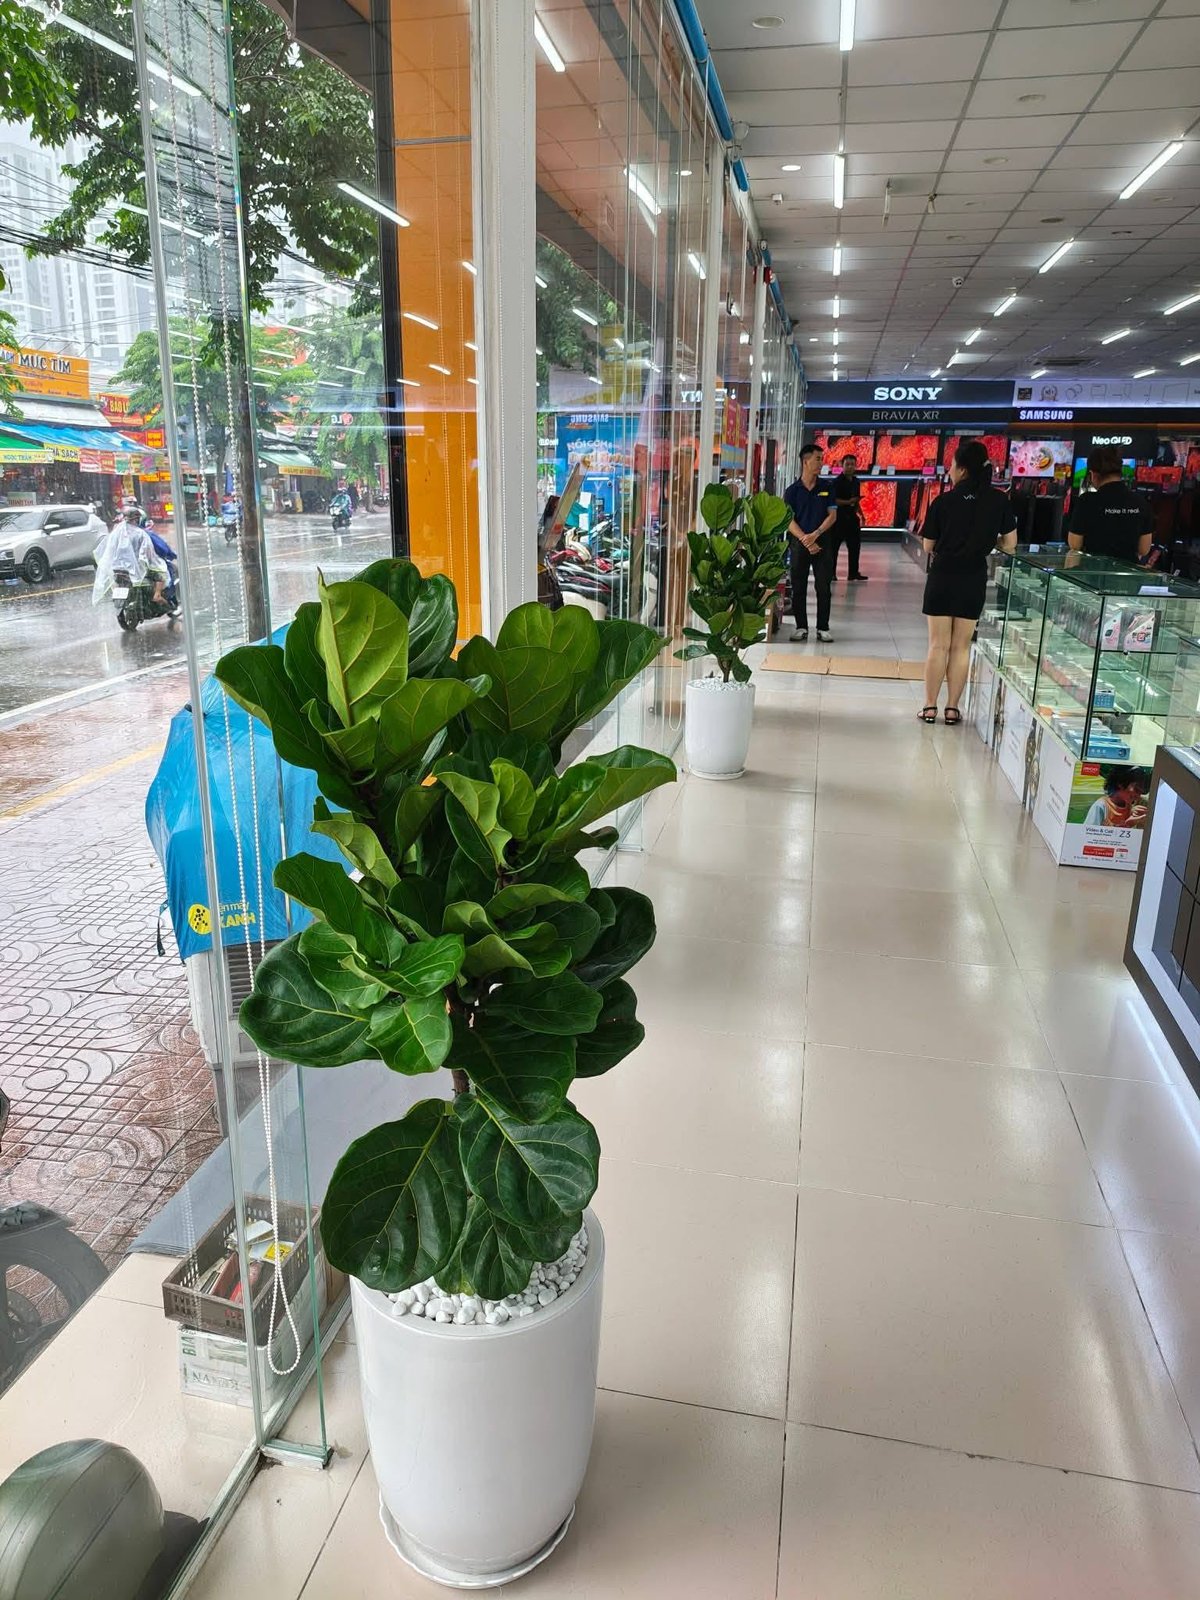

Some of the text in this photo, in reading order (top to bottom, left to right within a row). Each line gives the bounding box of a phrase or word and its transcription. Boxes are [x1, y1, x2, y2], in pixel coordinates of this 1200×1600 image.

[874, 387, 943, 401] SONY
[872, 410, 940, 420] BRAVIA XR
[1019, 410, 1073, 420] SAMSUNG
[1092, 436, 1110, 445] Neo
[1120, 830, 1131, 838] Z3
